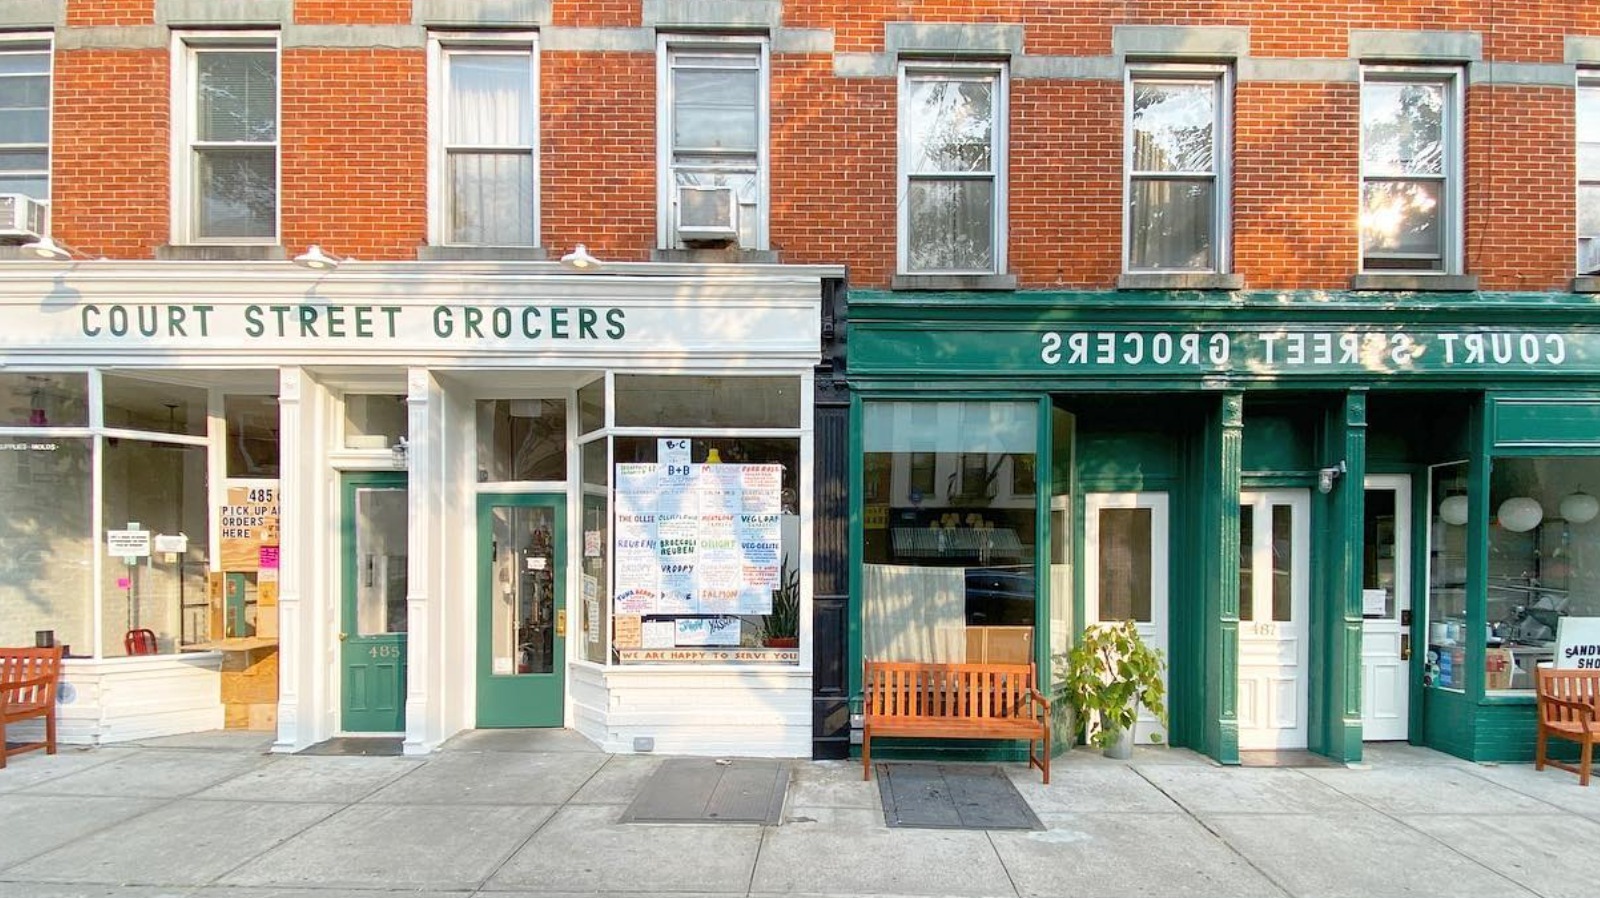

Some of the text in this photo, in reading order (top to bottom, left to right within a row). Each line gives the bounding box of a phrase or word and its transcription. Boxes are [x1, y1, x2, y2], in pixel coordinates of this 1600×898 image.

[81, 305, 626, 340] COURT STREET GROCERS
[249, 489, 272, 502] 485
[222, 506, 249, 516] PICK
[254, 506, 268, 516] UP
[222, 517, 264, 526] ORDERS
[634, 515, 655, 523] OLLIE
[222, 529, 250, 538] HERE
[368, 645, 400, 658] 485
[735, 652, 766, 660] SERVE
[774, 652, 797, 660] YOU
